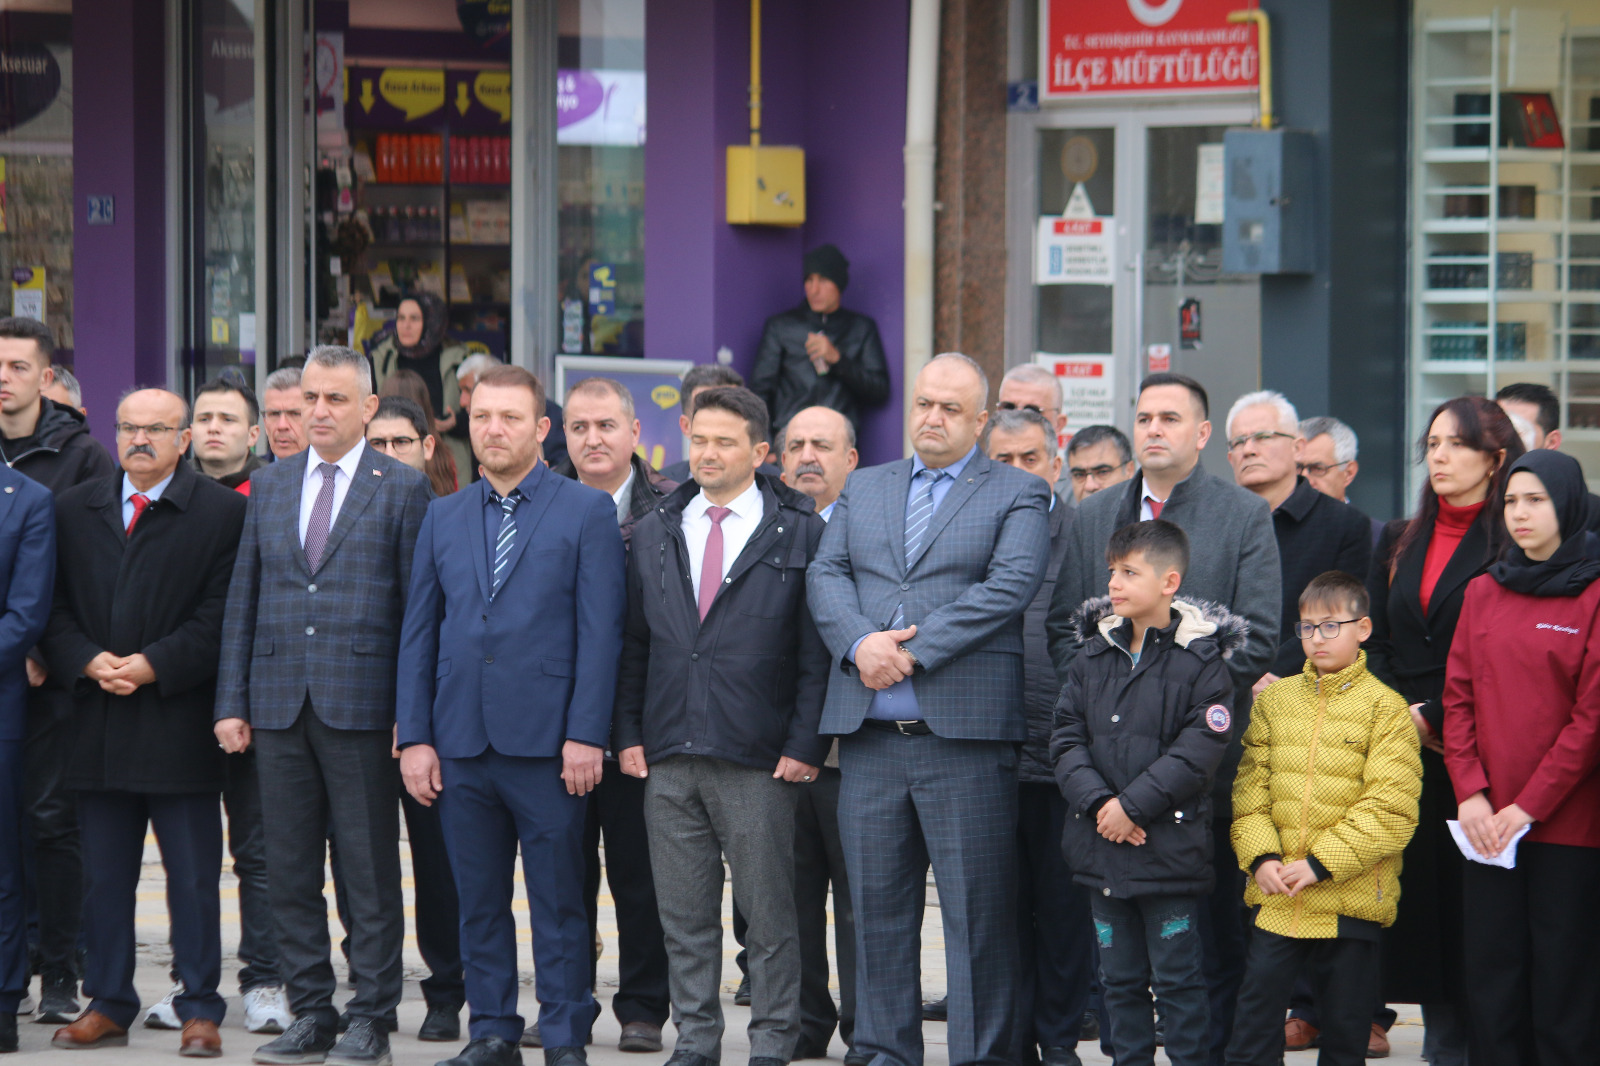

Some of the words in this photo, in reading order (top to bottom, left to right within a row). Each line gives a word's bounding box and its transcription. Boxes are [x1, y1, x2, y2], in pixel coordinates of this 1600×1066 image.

[1054, 53, 1107, 91] İLÇE
[1111, 45, 1259, 86] MÜFTÜLÜĞÜ
[1016, 85, 1030, 107] 2
